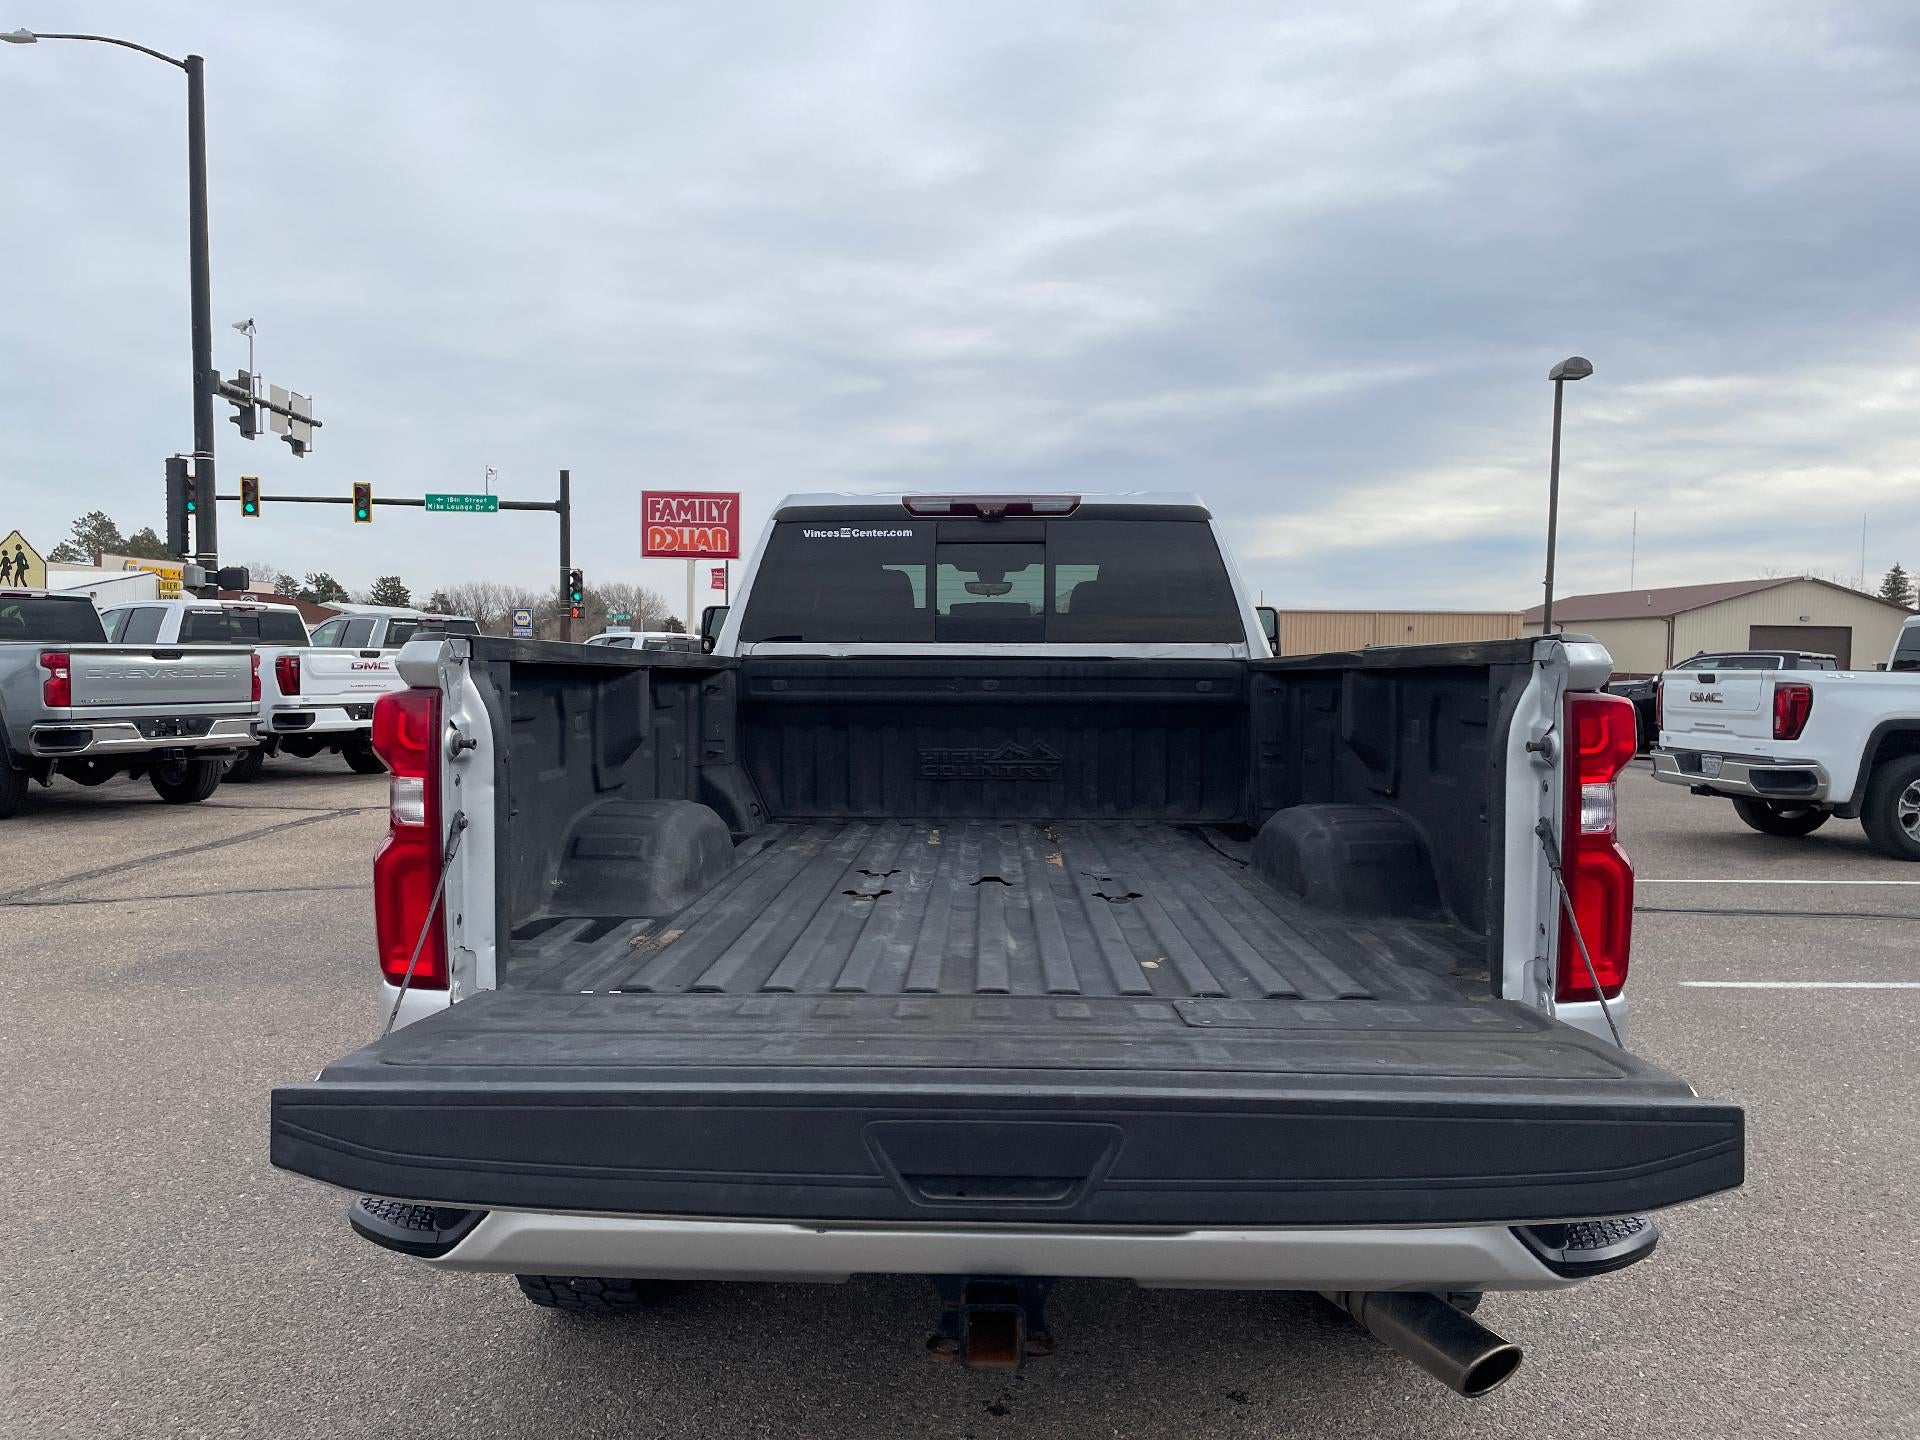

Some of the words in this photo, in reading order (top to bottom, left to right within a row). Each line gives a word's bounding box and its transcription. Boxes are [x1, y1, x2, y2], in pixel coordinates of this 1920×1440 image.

[647, 497, 733, 524] FAMILY
[647, 525, 730, 553] DOLLAR
[351, 661, 390, 670] GMC
[85, 667, 241, 679] CHEVROLET
[1689, 691, 1724, 704] GMC
